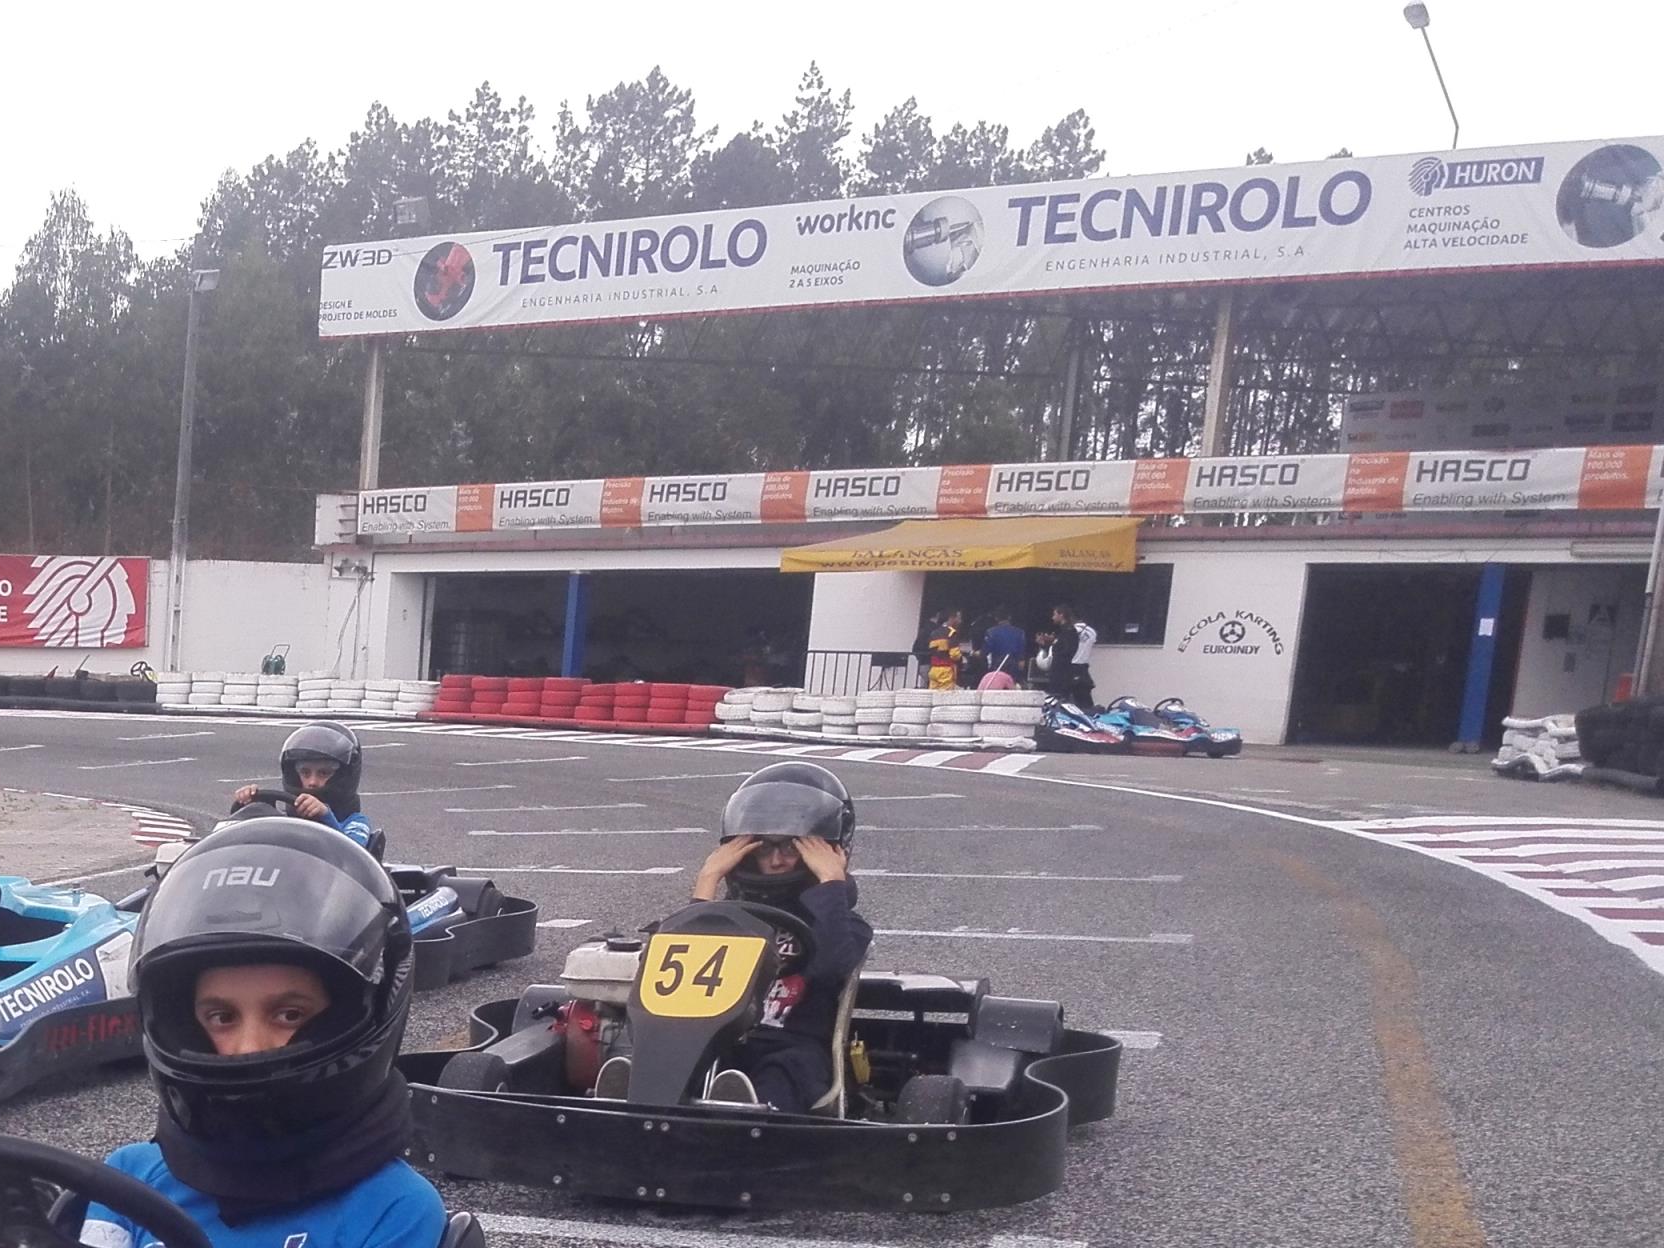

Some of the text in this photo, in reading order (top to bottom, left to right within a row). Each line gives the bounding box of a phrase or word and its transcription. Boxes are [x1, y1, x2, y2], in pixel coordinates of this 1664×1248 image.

[1454, 160, 1537, 185] HURON
[1008, 170, 1373, 247] TECNIROLO
[1409, 204, 1471, 219] CENTROS
[796, 203, 896, 236] worknc
[1406, 216, 1501, 234] MAQUINAÇÃO
[1403, 232, 1529, 250] ALTA VELOCIDADE
[492, 219, 768, 286] TECNIROLO
[790, 258, 861, 275] MAQUINAÇÃO
[1045, 254, 1150, 272] ENGENHARIA
[789, 279, 796, 288] 2
[796, 278, 804, 288] A
[814, 275, 844, 287] EIXOS
[347, 300, 353, 309] E
[522, 292, 603, 308] ENGENHARIA
[319, 308, 398, 322] PROJETO DE MOLDES
[1195, 463, 1301, 488] HASCO
[1415, 458, 1531, 483] HASCO
[814, 475, 901, 499] HASCO
[995, 469, 1091, 493] HASCO
[499, 487, 571, 509] HASCO
[649, 481, 728, 504] HASCO
[1412, 492, 1474, 507] Enabling
[1478, 492, 1507, 505] with
[362, 494, 428, 515] HASCO
[813, 506, 859, 518] Enabling
[861, 506, 883, 517] with
[994, 501, 1045, 513] Enabling
[1049, 500, 1071, 512] with
[1193, 496, 1248, 510] Enabling
[1252, 496, 1278, 508] with
[498, 517, 536, 528] Enabling
[537, 515, 557, 527] with
[647, 511, 690, 523] Enabling
[692, 510, 712, 521] with
[361, 521, 398, 534] Enabling
[1177, 609, 1284, 655] ESCOLA KARTING
[1202, 644, 1261, 655] EUROINDY
[201, 866, 281, 890] nau
[653, 943, 725, 998] 54
